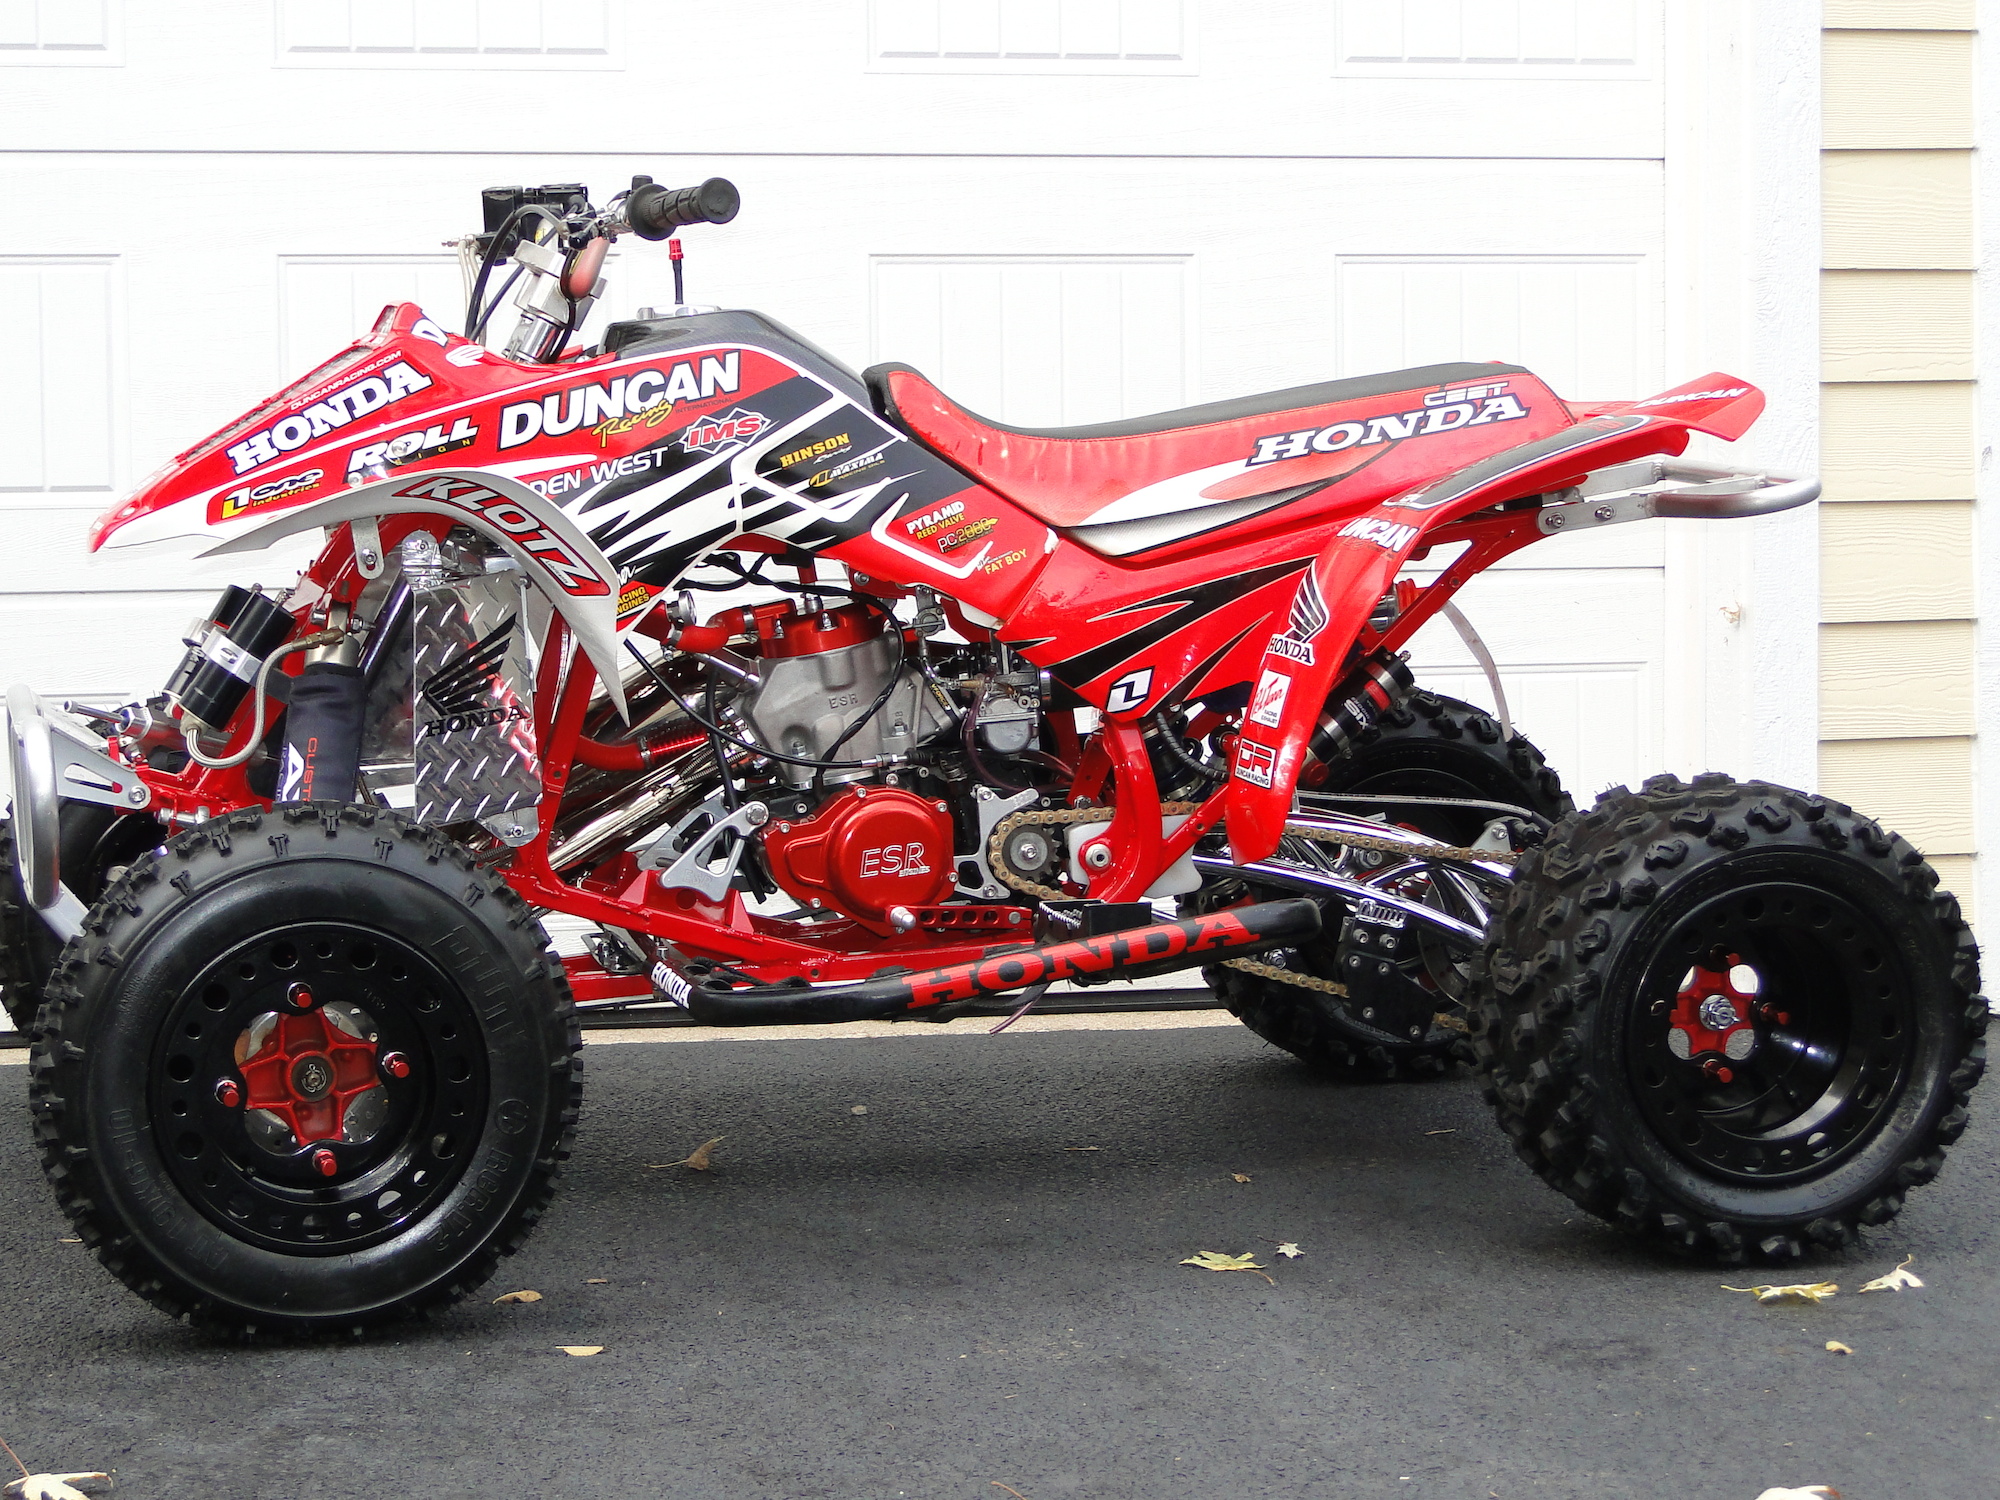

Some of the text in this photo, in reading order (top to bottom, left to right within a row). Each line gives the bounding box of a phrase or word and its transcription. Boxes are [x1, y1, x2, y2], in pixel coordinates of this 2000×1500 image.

[290, 350, 402, 410] DUNCANRACING.COM
[1634, 387, 1748, 408] DUNCAN
[226, 361, 432, 475] HONDA
[499, 351, 740, 450] DUNCAN
[675, 398, 733, 414] INTERNATIONAL
[592, 399, 673, 448] Racing
[688, 416, 763, 448] IMS
[1247, 394, 1530, 466] HONDA
[347, 416, 480, 473] ROLL
[780, 433, 850, 468] HINSON
[530, 446, 669, 497] DEN WEST
[252, 482, 320, 507] industries
[405, 477, 602, 589] KLOTZ
[906, 500, 966, 535] PYRAMID
[916, 512, 965, 540] REED VALVE
[1336, 517, 1420, 553] UNCAN
[984, 559, 1004, 575] FAT
[1005, 548, 1028, 566] BOY
[617, 593, 650, 614] NGINES
[618, 586, 646, 604] ACING
[1268, 637, 1312, 664] HONDA
[829, 693, 859, 709] ESR
[424, 705, 528, 738] HONDA
[1238, 740, 1273, 777] DR
[1251, 772, 1270, 786] RACING
[860, 842, 926, 878] ESR
[901, 913, 1261, 1010] HONDA
[651, 961, 693, 1009] HONDA
